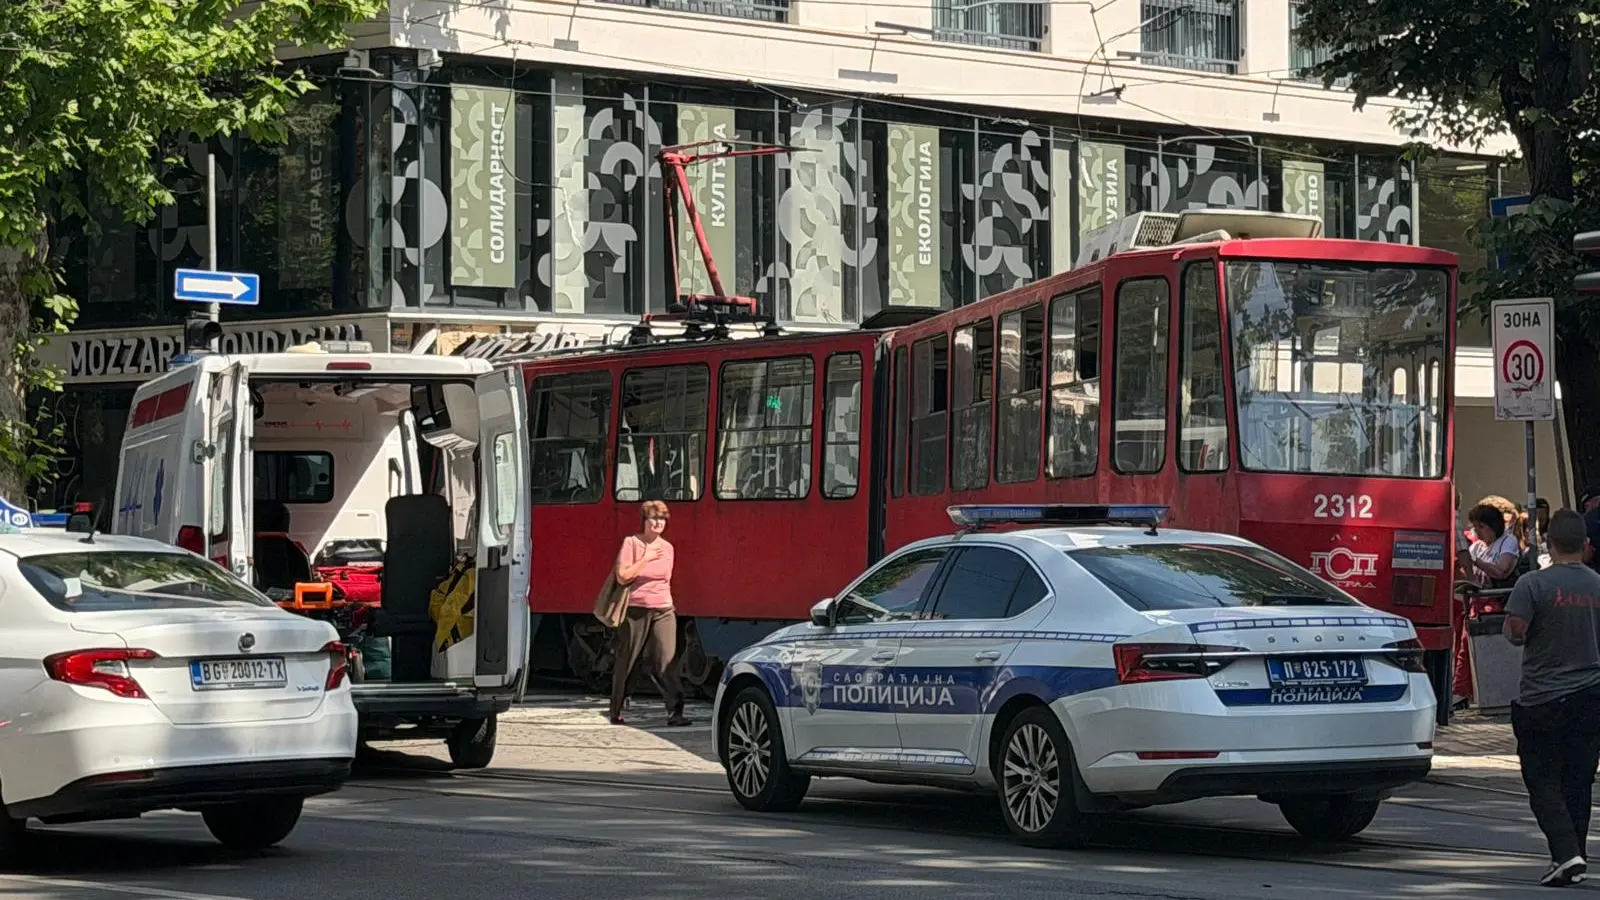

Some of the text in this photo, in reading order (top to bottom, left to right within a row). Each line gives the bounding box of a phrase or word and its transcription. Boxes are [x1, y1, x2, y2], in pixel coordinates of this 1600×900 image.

[489, 103, 506, 264] СОЛИДАРНОСТ
[711, 123, 727, 228] КУЛТУА
[918, 141, 932, 265] ЕКОЛОГИЈА
[1105, 158, 1119, 225] УЗИЈА
[1503, 311, 1541, 328] ЗОНА
[1511, 353, 1535, 381] 30
[1313, 494, 1373, 518] 2312
[203, 662, 221, 680] BG
[833, 672, 955, 685] САОБРАЋАЈНА
[833, 685, 955, 708] ПОЛИЦИЈА
[1270, 691, 1363, 703] ПОЛИЦИЈА
